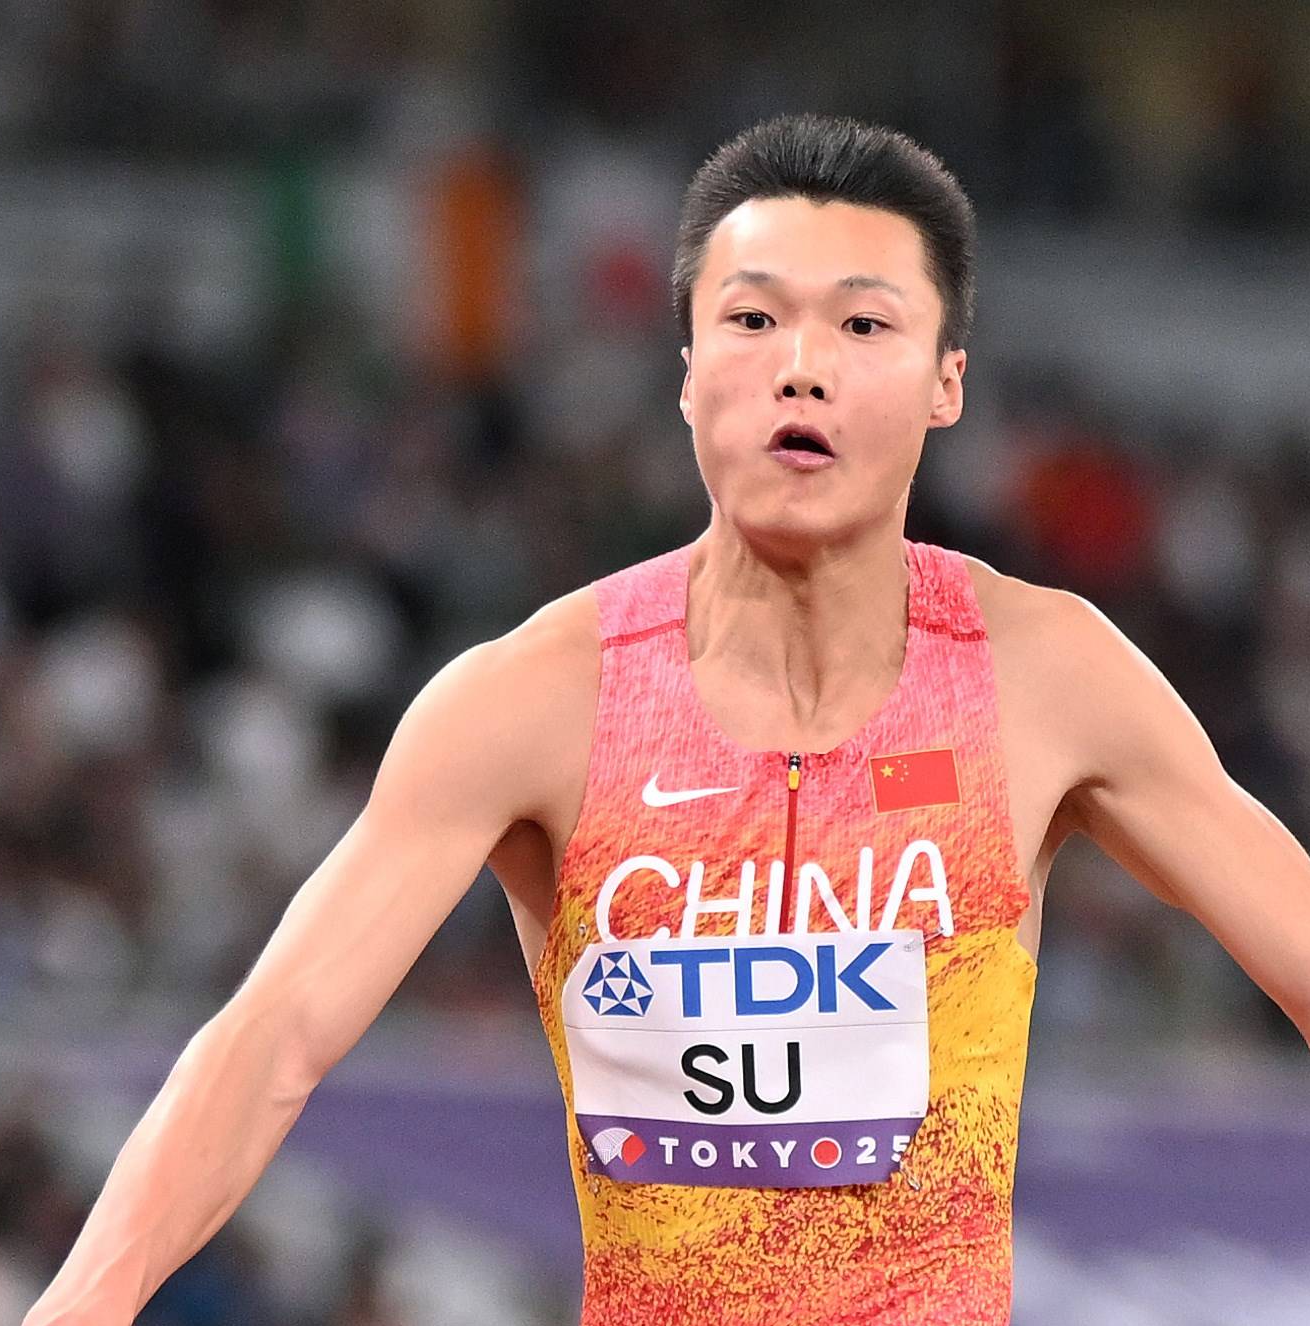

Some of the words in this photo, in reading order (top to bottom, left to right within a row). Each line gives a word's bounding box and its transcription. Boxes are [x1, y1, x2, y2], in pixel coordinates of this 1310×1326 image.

[595, 839, 954, 944] CHINA
[650, 942, 898, 1018] TDK
[680, 1041, 802, 1116] SU
